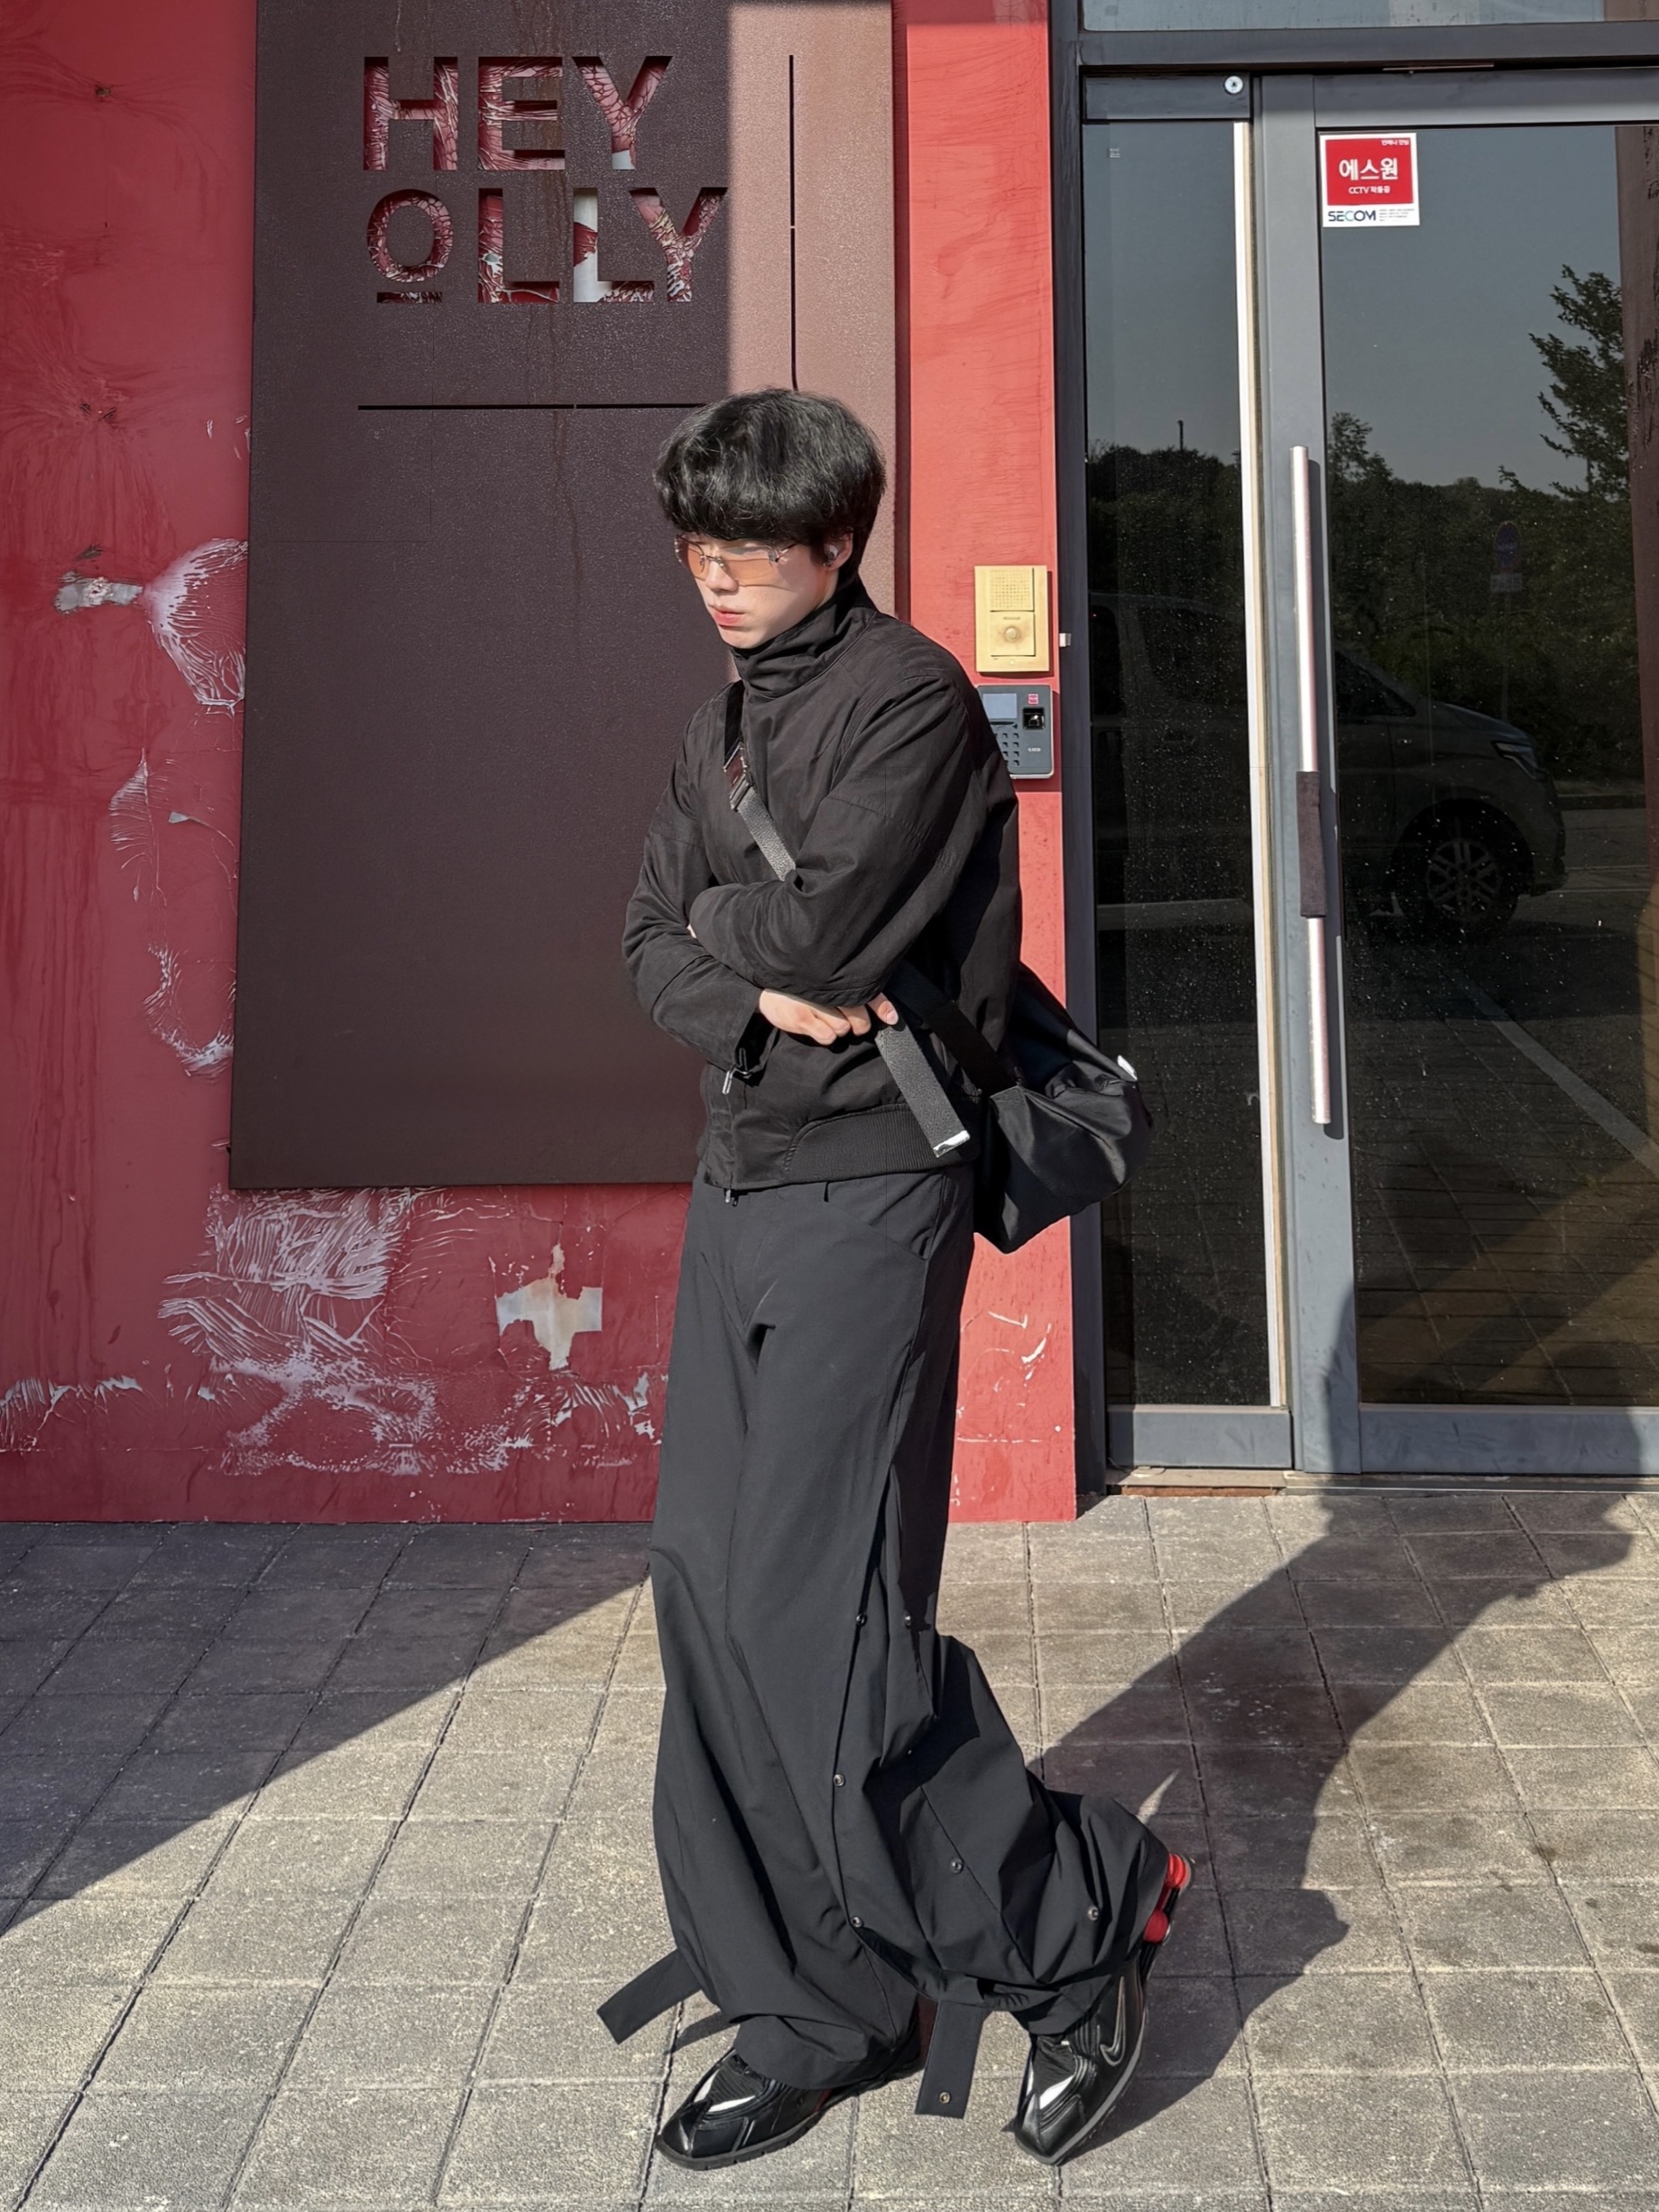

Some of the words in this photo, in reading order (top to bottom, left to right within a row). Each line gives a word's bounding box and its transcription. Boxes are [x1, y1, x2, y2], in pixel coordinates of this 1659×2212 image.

[364, 56, 674, 171] HEY
[1339, 158, 1398, 180] 에스원
[366, 188, 728, 303] OLLY
[1328, 209, 1377, 222] SECOM
